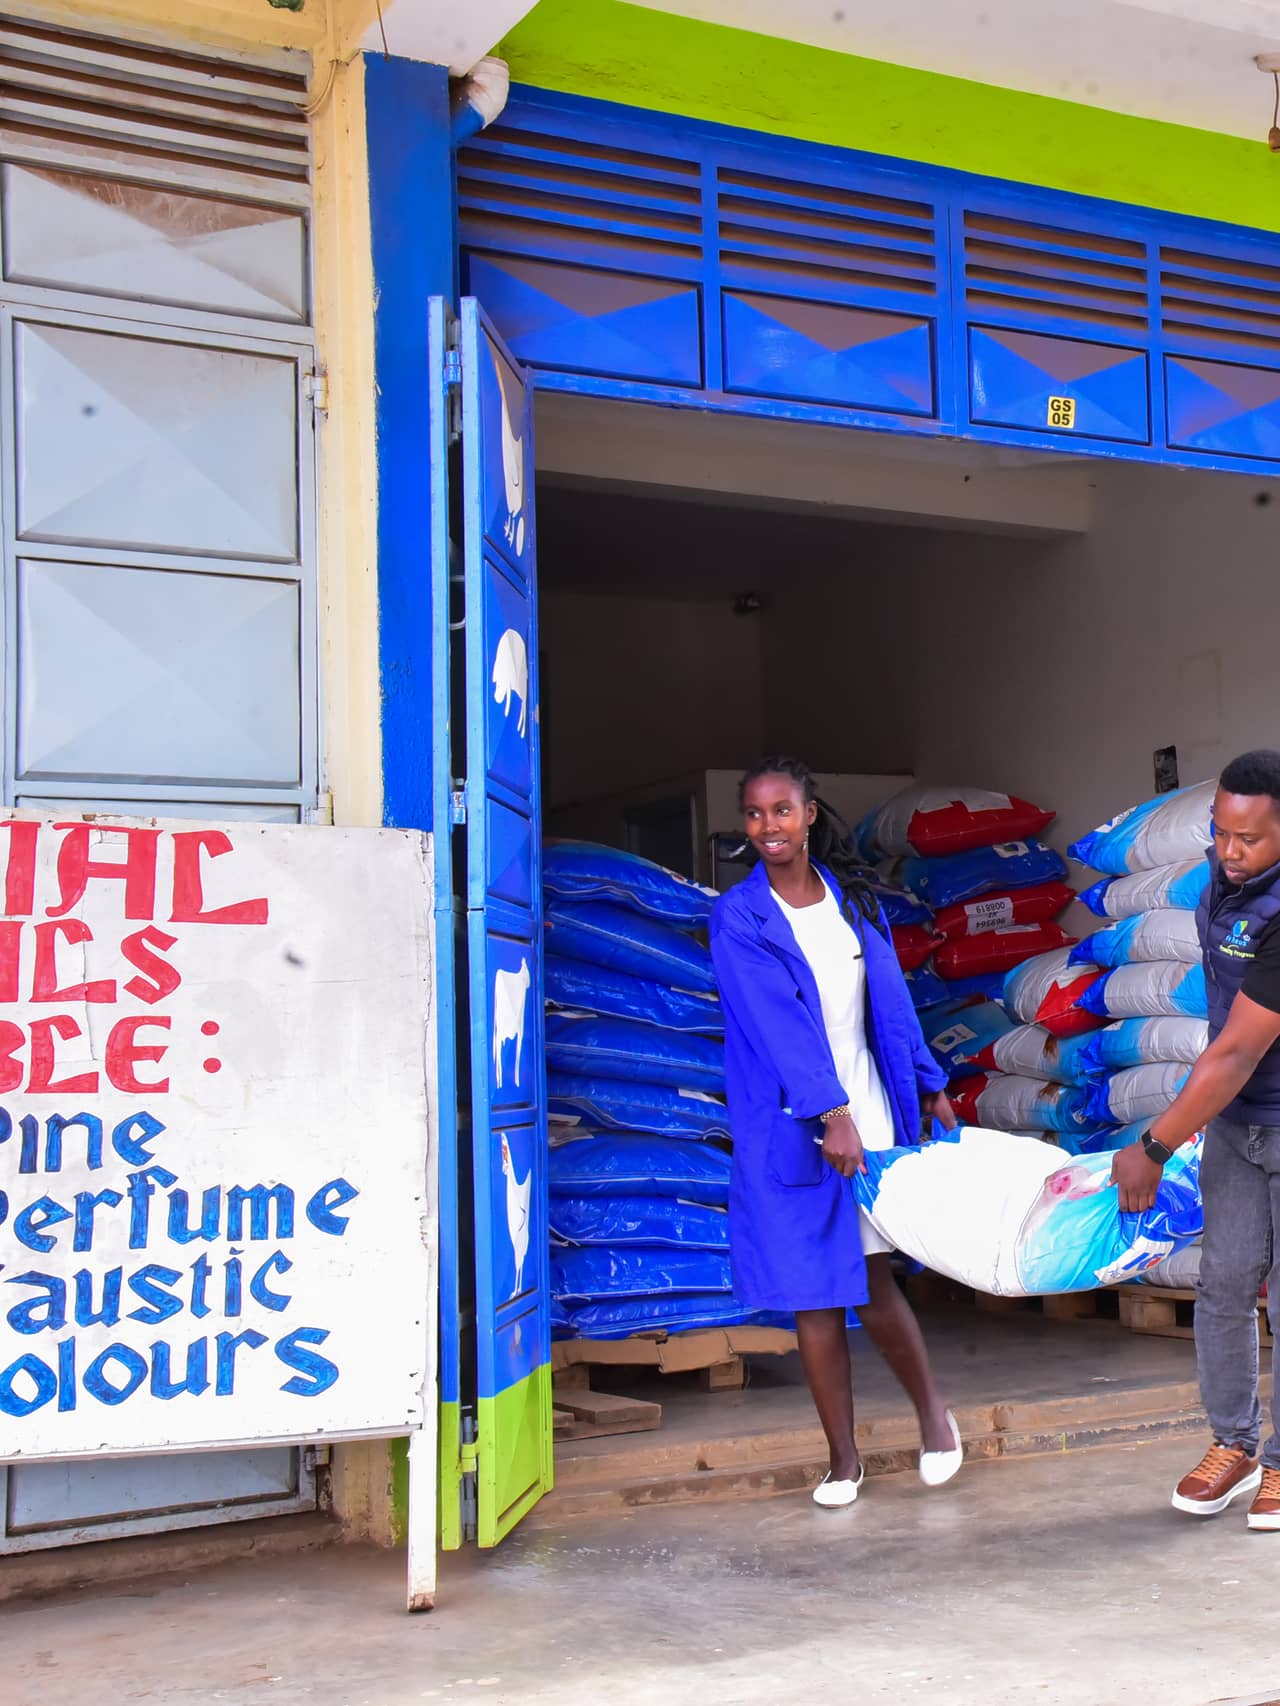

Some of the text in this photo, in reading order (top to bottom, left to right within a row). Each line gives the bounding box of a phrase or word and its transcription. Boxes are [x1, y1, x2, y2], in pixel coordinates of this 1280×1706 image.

[1051, 399, 1071, 412] GS
[1052, 412, 1070, 426] 05
[0, 1246, 293, 1335] austic
